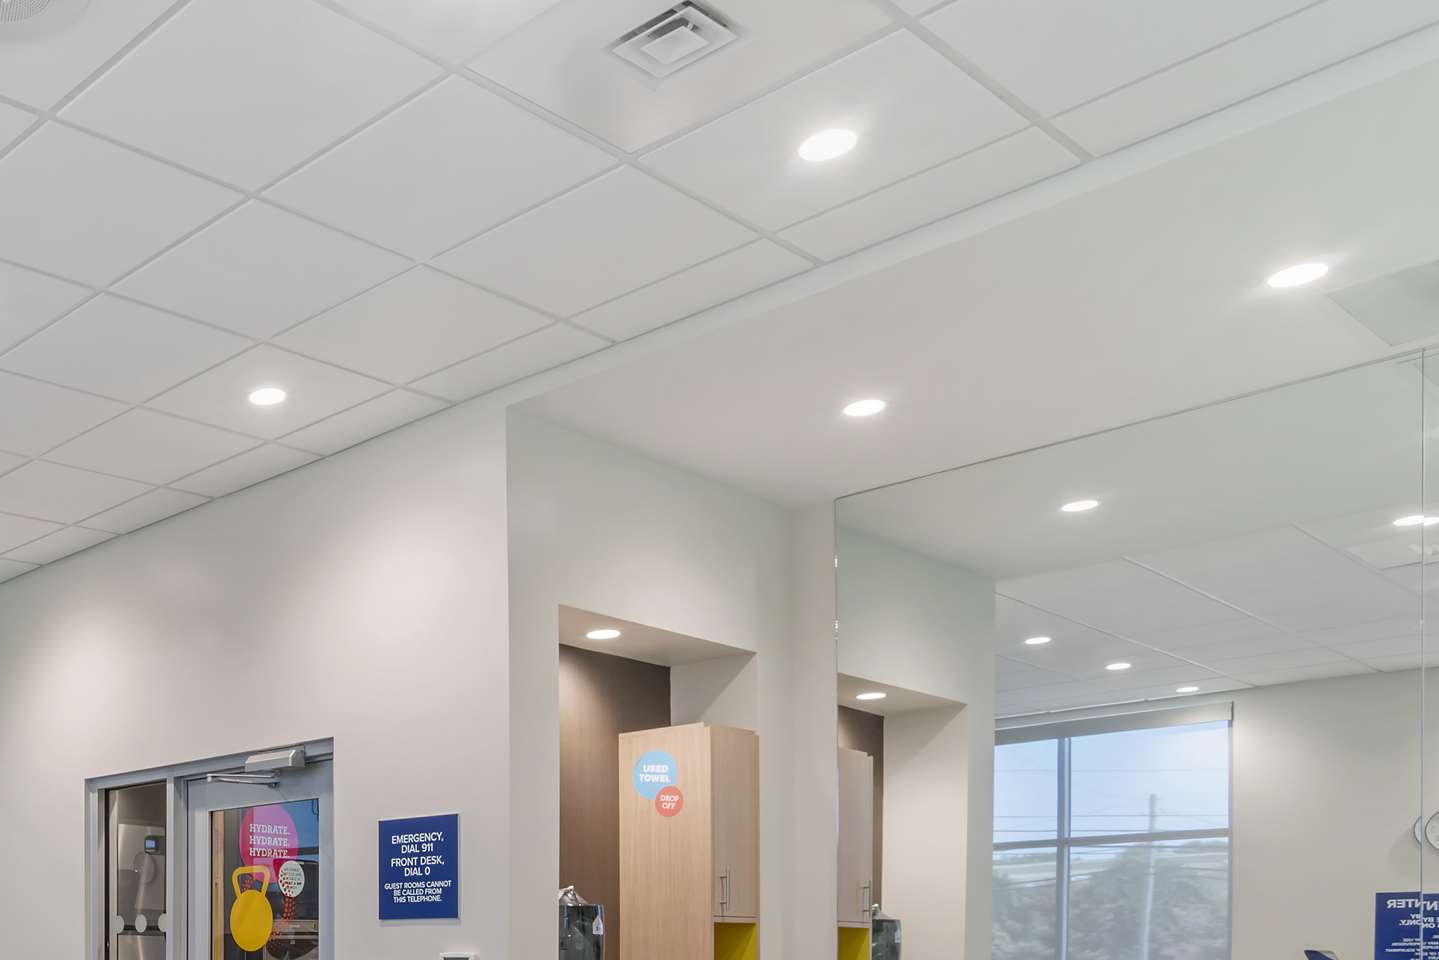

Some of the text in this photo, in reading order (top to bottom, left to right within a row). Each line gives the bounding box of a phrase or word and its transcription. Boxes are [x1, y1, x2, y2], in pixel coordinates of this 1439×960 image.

[643, 764, 669, 773] USED
[640, 774, 671, 783] TOWEL
[249, 823, 291, 835] HYDRATE.
[249, 835, 291, 847] HYDRATE.
[391, 831, 444, 845] EMERGENCY,
[249, 847, 291, 859] HYDRATE.
[401, 842, 434, 853] DIAL 911
[391, 855, 445, 867] FRONT DESK,
[404, 866, 431, 876] DIAL 0
[384, 882, 403, 890] GUEST
[426, 879, 452, 887] CANNOT
[401, 888, 424, 896] CALLED
[406, 894, 443, 903] TELEPHONE.
